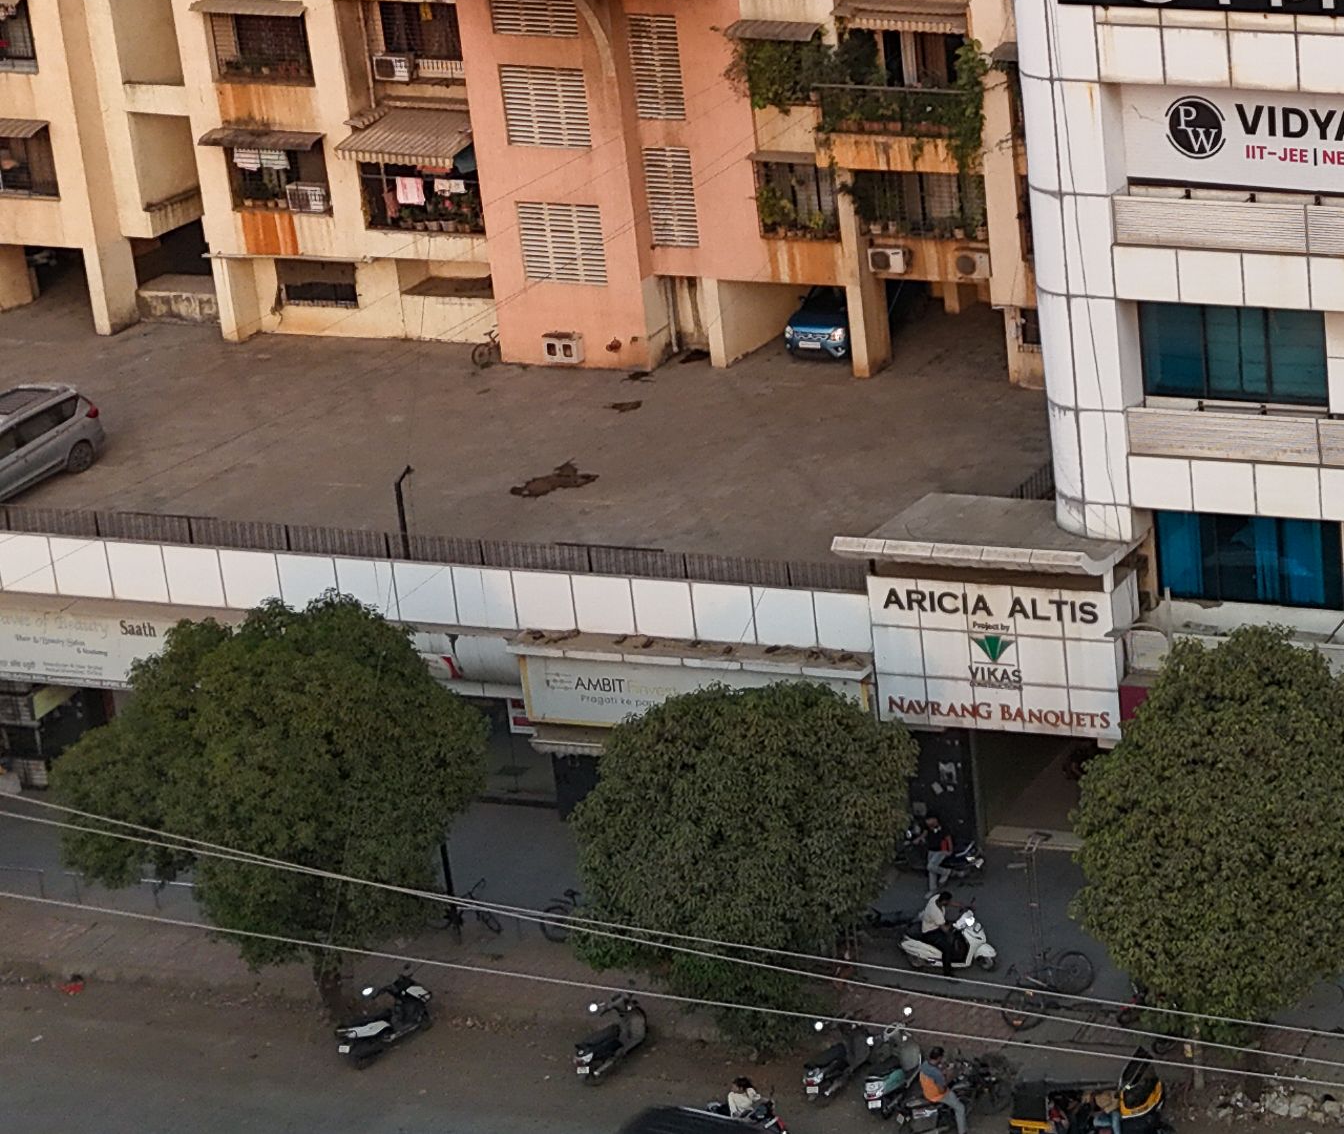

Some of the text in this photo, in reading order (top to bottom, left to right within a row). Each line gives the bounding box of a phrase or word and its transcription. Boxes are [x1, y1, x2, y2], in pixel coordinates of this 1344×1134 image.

[1245, 144, 1309, 164] IIT-JEE
[883, 587, 1099, 625] ARICIA ALTIS
[119, 619, 157, 638] Saath
[968, 664, 1023, 685] VIKAS
[574, 676, 625, 694] AMBIT
